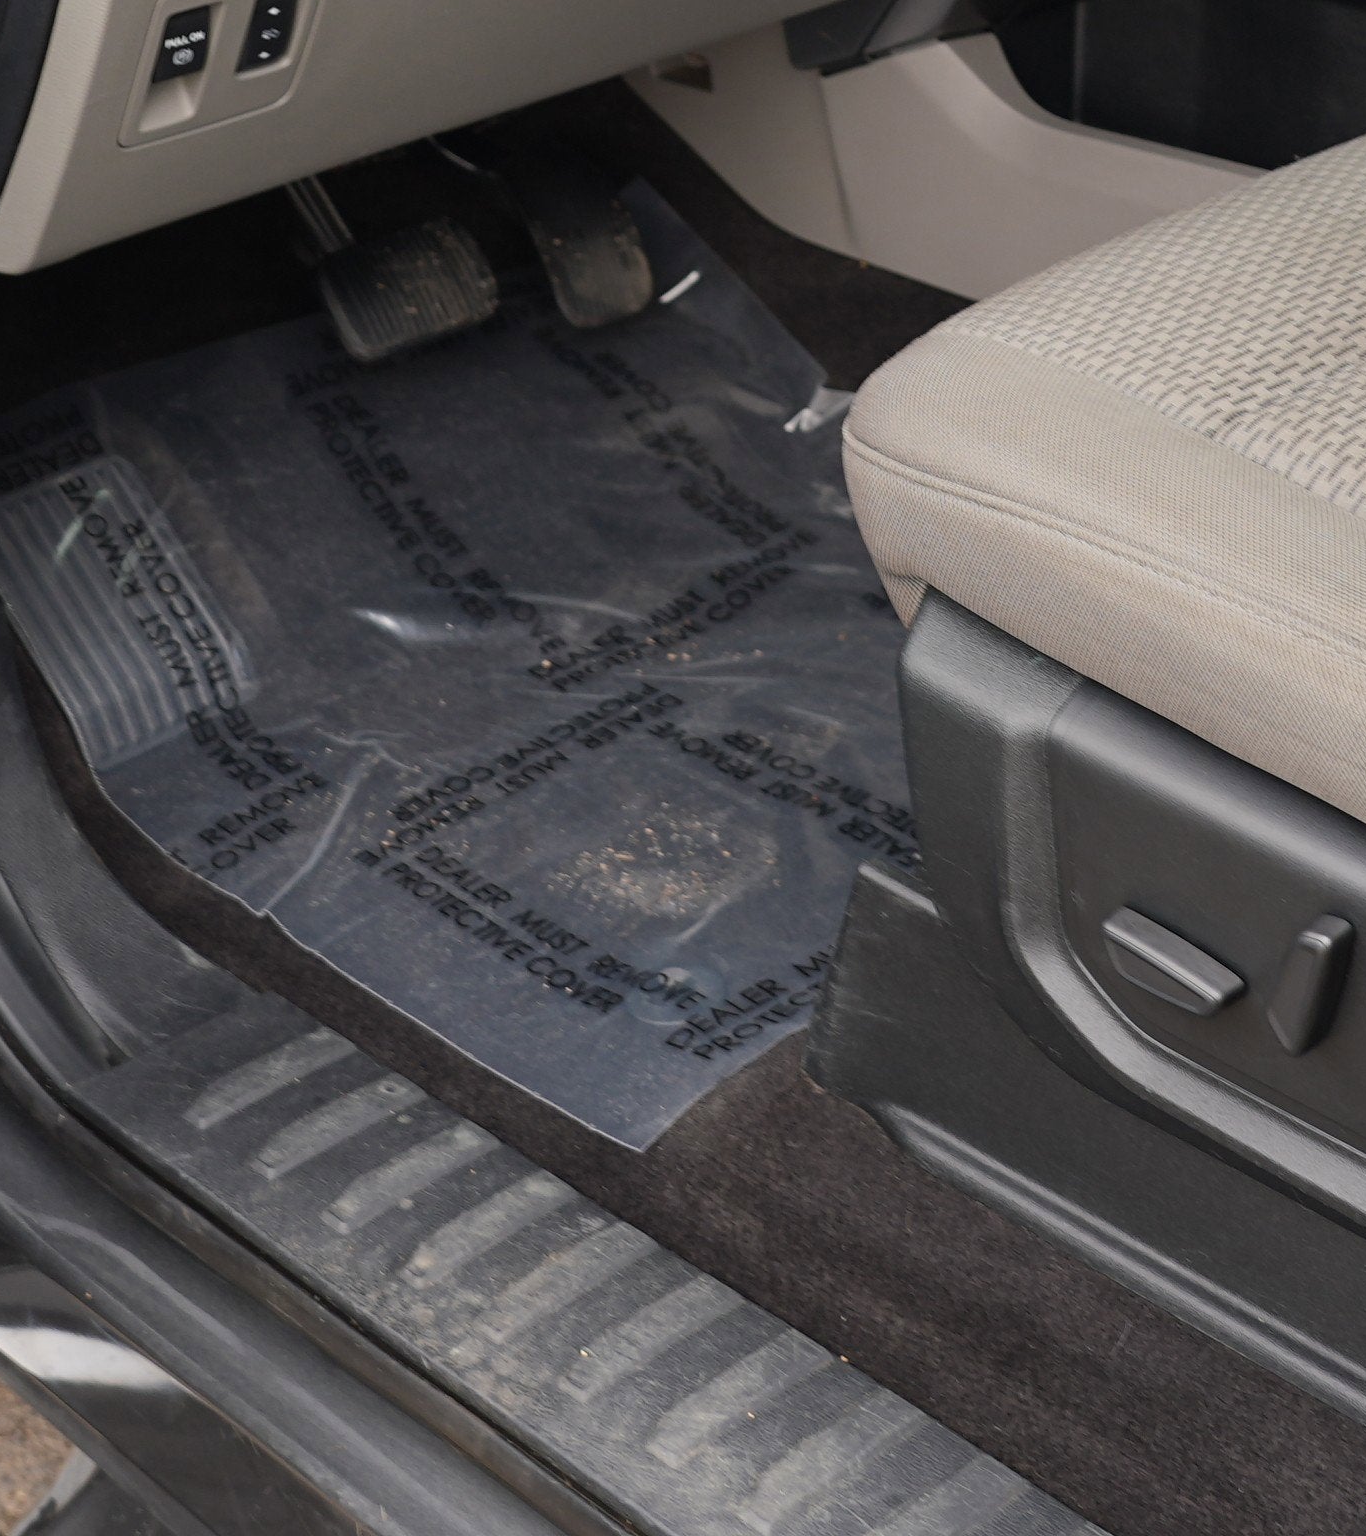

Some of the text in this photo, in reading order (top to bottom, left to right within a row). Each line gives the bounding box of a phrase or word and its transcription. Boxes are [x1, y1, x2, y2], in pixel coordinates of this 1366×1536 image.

[138, 609, 196, 691] MUST
[184, 706, 272, 793] DEALER
[495, 751, 569, 798] MUST
[196, 770, 328, 847] REMOVE
[392, 764, 494, 824] COVER
[837, 815, 919, 868] EALER
[382, 860, 624, 1014] PROTECTIVE COVER
[414, 845, 707, 1012] DEALER MUST REMOVE
[664, 975, 786, 1050] DEALER
